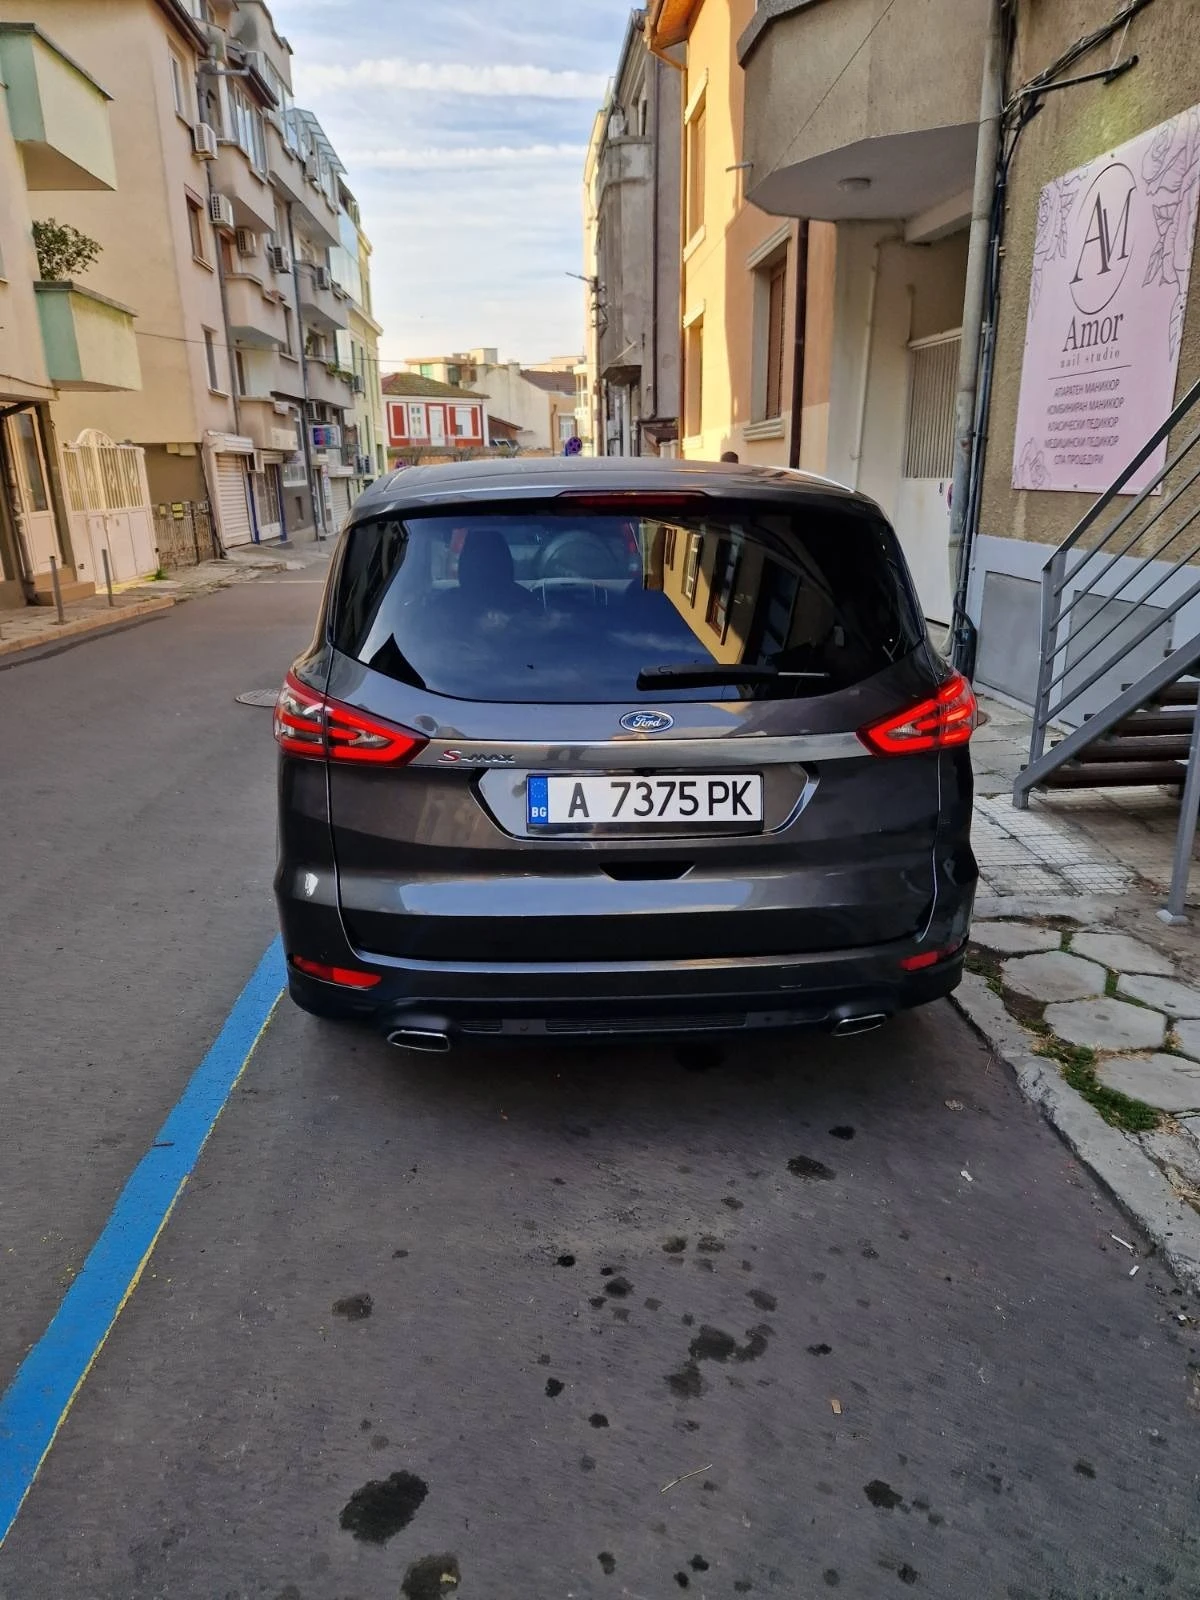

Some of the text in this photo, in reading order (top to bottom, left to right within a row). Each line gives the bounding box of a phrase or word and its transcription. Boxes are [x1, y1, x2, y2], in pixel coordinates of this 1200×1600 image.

[1062, 314, 1124, 352] Amor
[632, 713, 661, 729] Ford
[531, 807, 547, 817] BG
[568, 780, 753, 818] A 7375 PK
